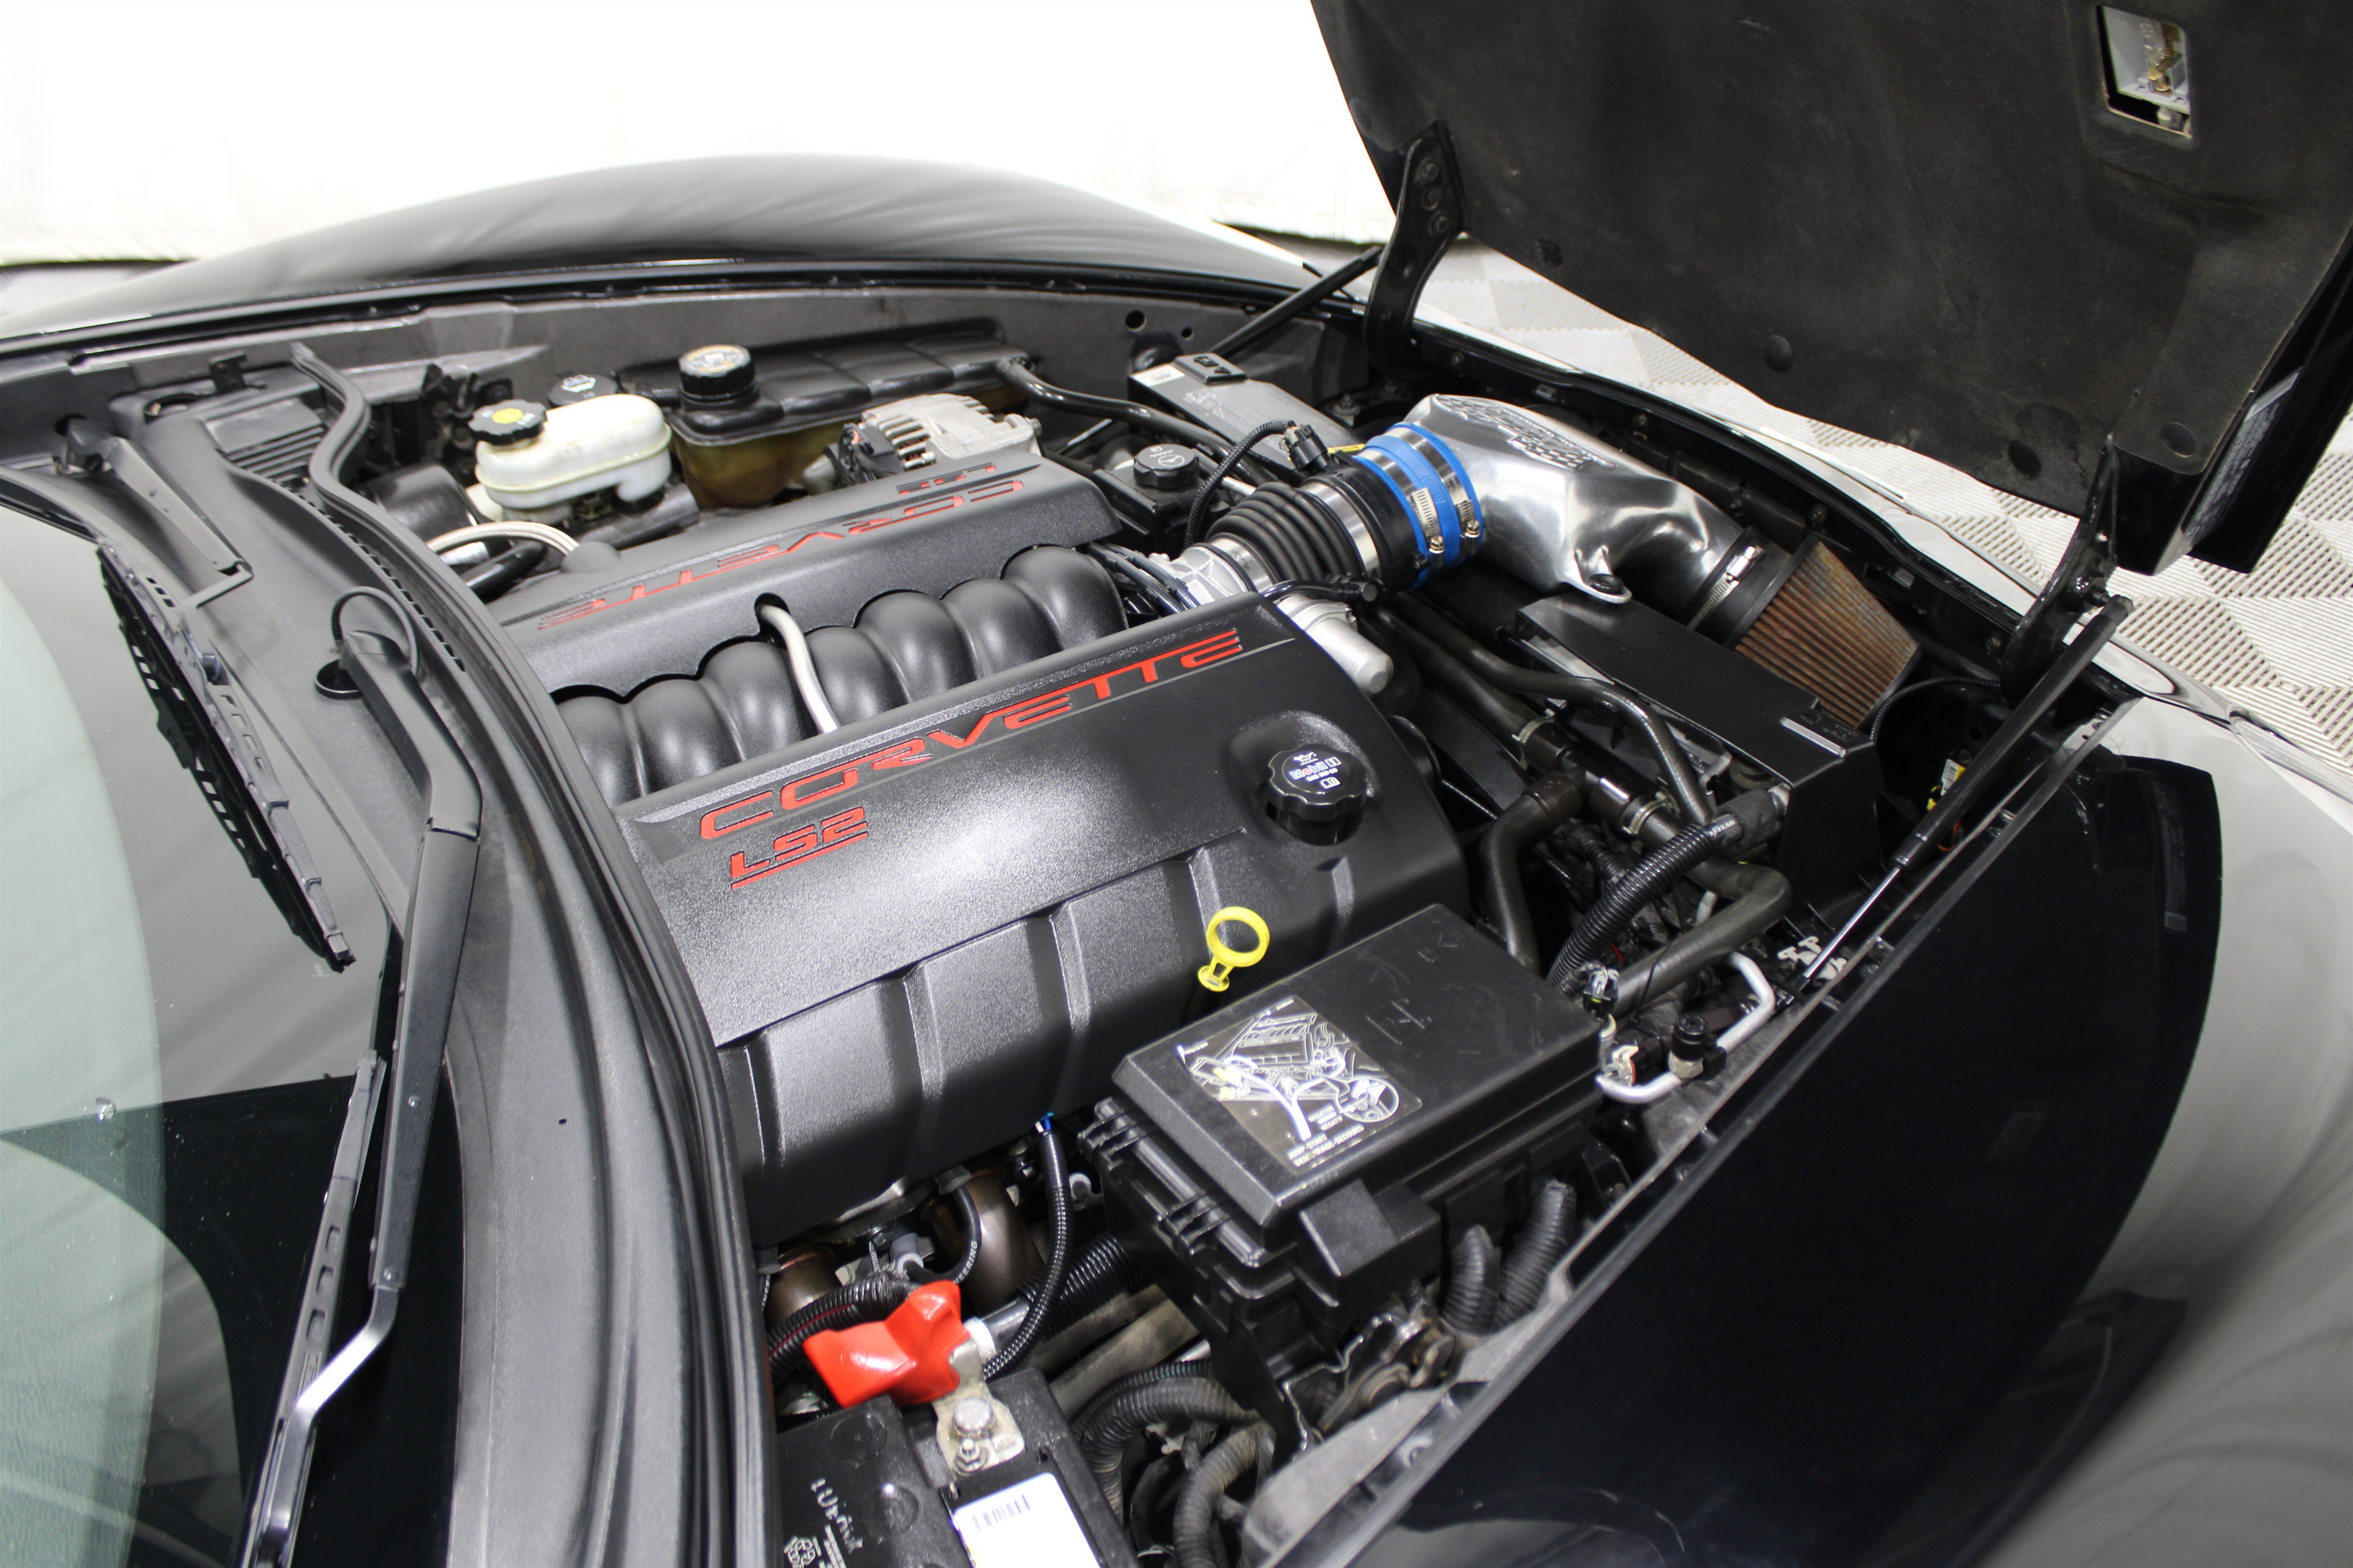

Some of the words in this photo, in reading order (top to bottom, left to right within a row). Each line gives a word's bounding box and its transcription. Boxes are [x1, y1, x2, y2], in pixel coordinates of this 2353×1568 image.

[538, 478, 1024, 630] CORVETTE
[699, 627, 1243, 840] CORVETTE
[1289, 761, 1329, 780] Mobil
[730, 806, 869, 880] LS2
